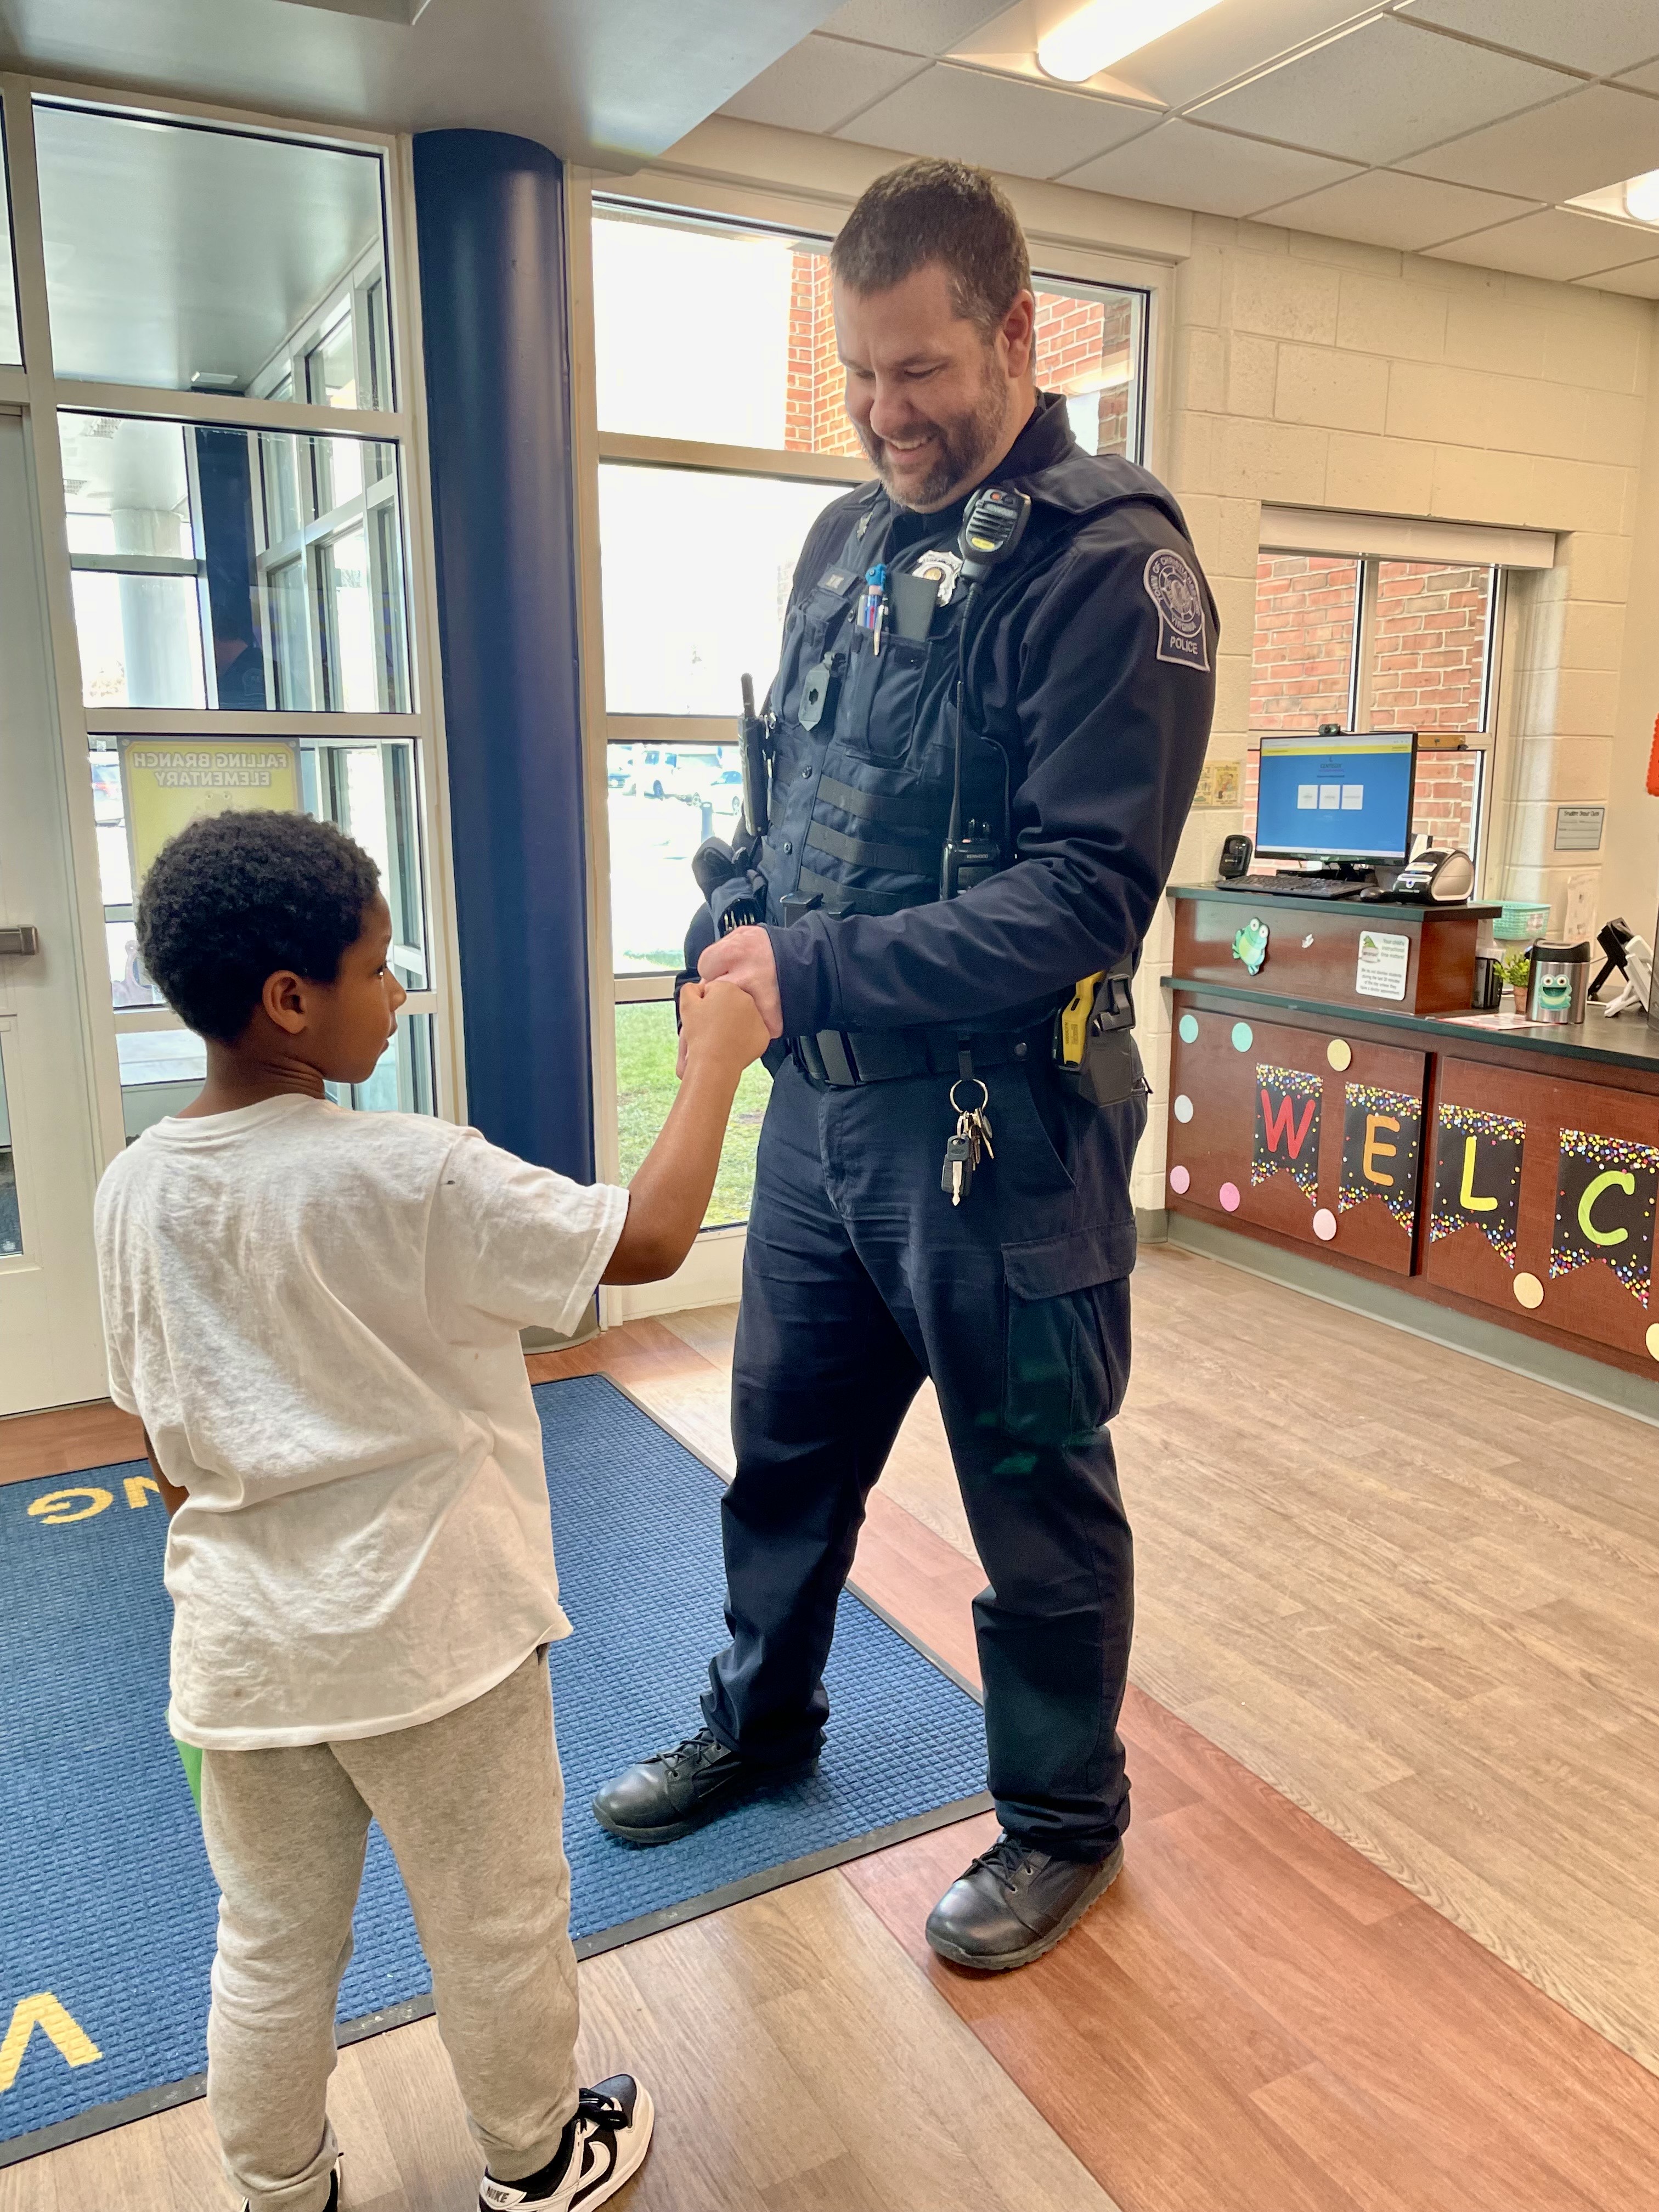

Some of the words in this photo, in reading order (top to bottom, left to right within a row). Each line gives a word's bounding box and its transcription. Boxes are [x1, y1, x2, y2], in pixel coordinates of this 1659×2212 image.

[1153, 561, 1160, 574] OF
[1150, 575, 1164, 602] TOWN
[1171, 613, 1197, 632] VIRGINIA
[1170, 635, 1198, 655] POLICE
[487, 2185, 510, 2203] NIKE
